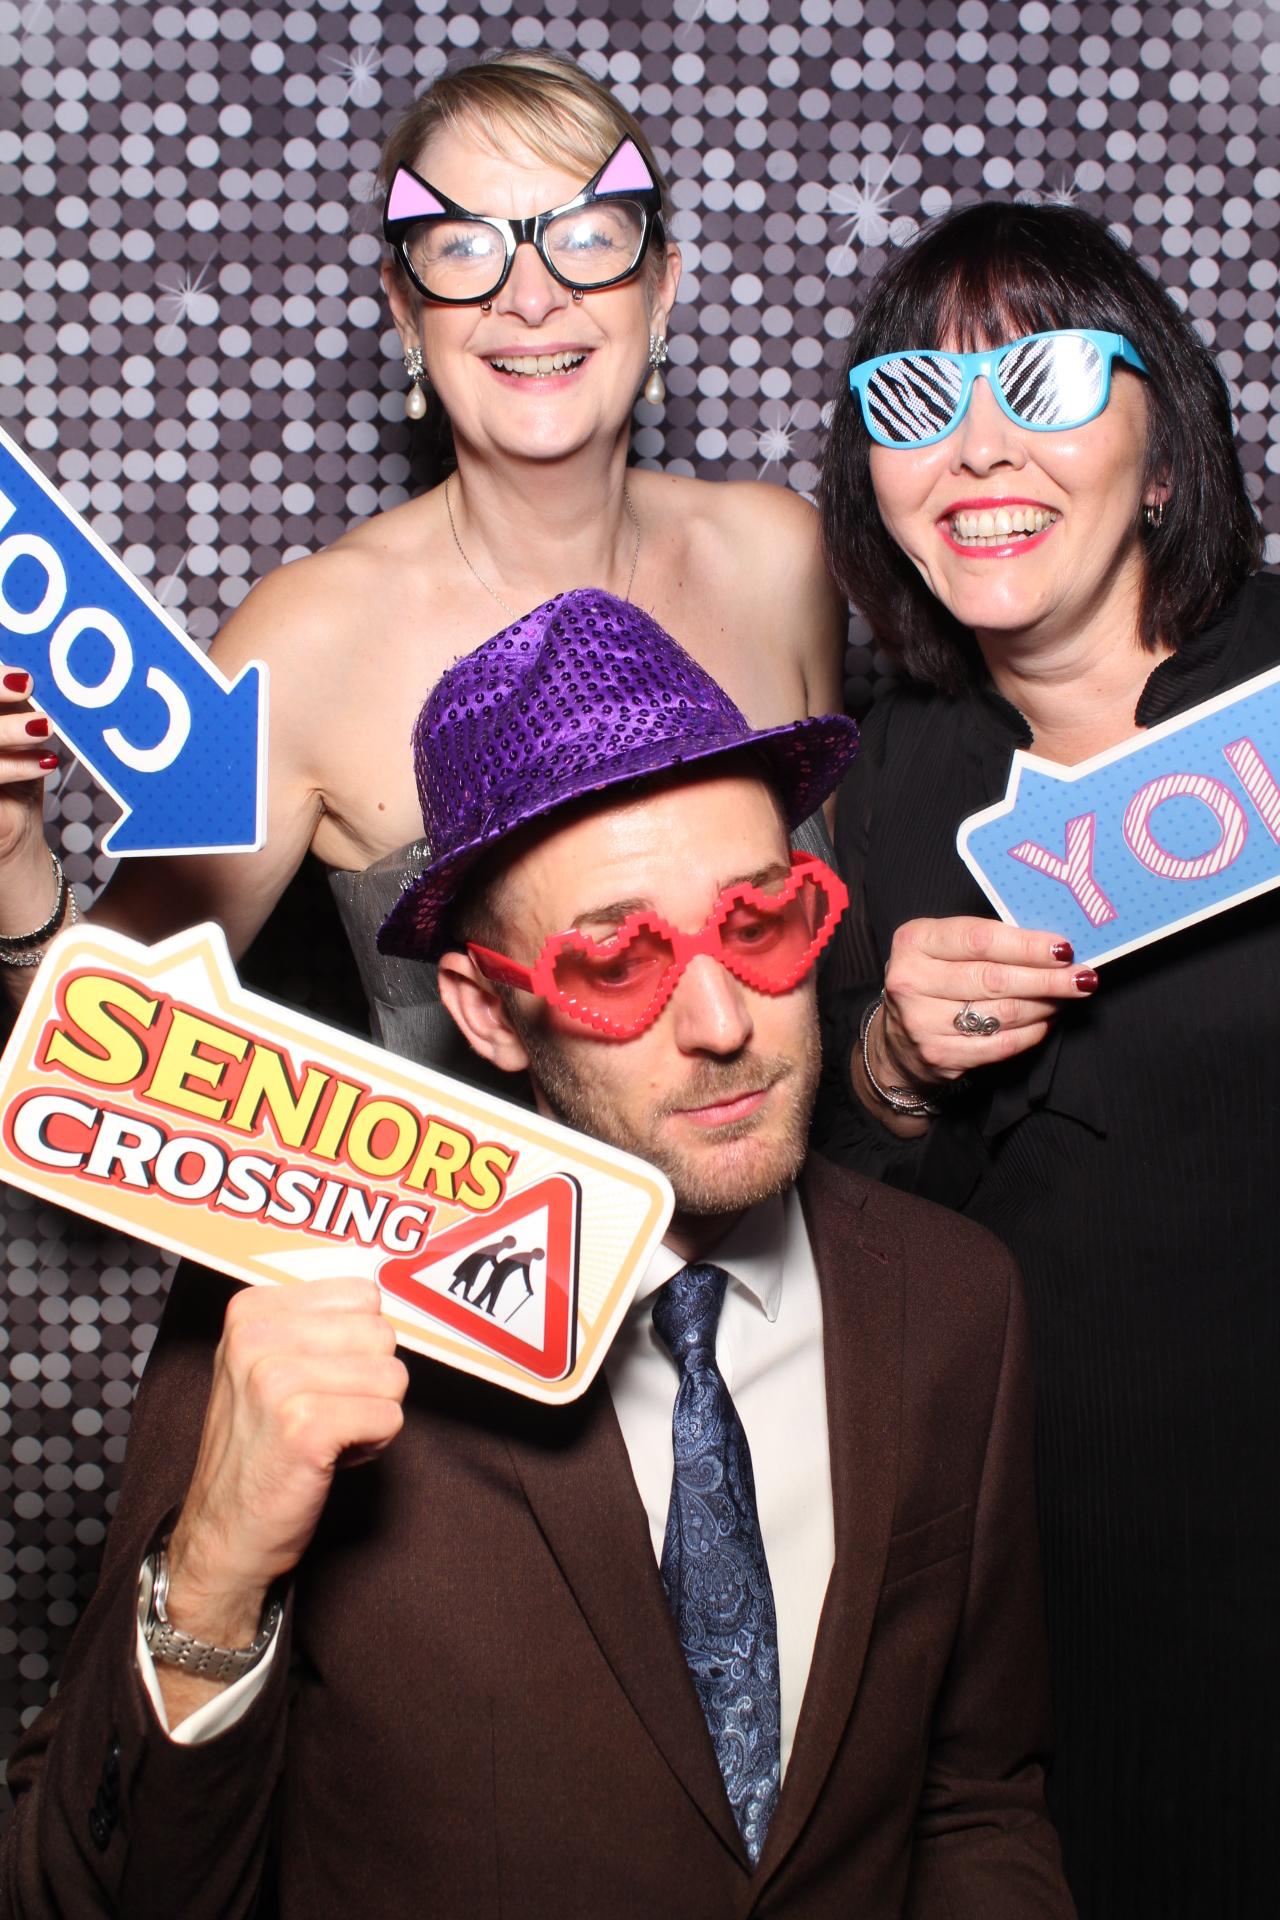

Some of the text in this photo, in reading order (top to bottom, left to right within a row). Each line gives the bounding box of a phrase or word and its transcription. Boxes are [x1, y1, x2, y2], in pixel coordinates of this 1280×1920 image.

[0, 491, 192, 773] COO
[12, 1094, 429, 1253] CROSSING
[43, 974, 515, 1211] SENIORS
